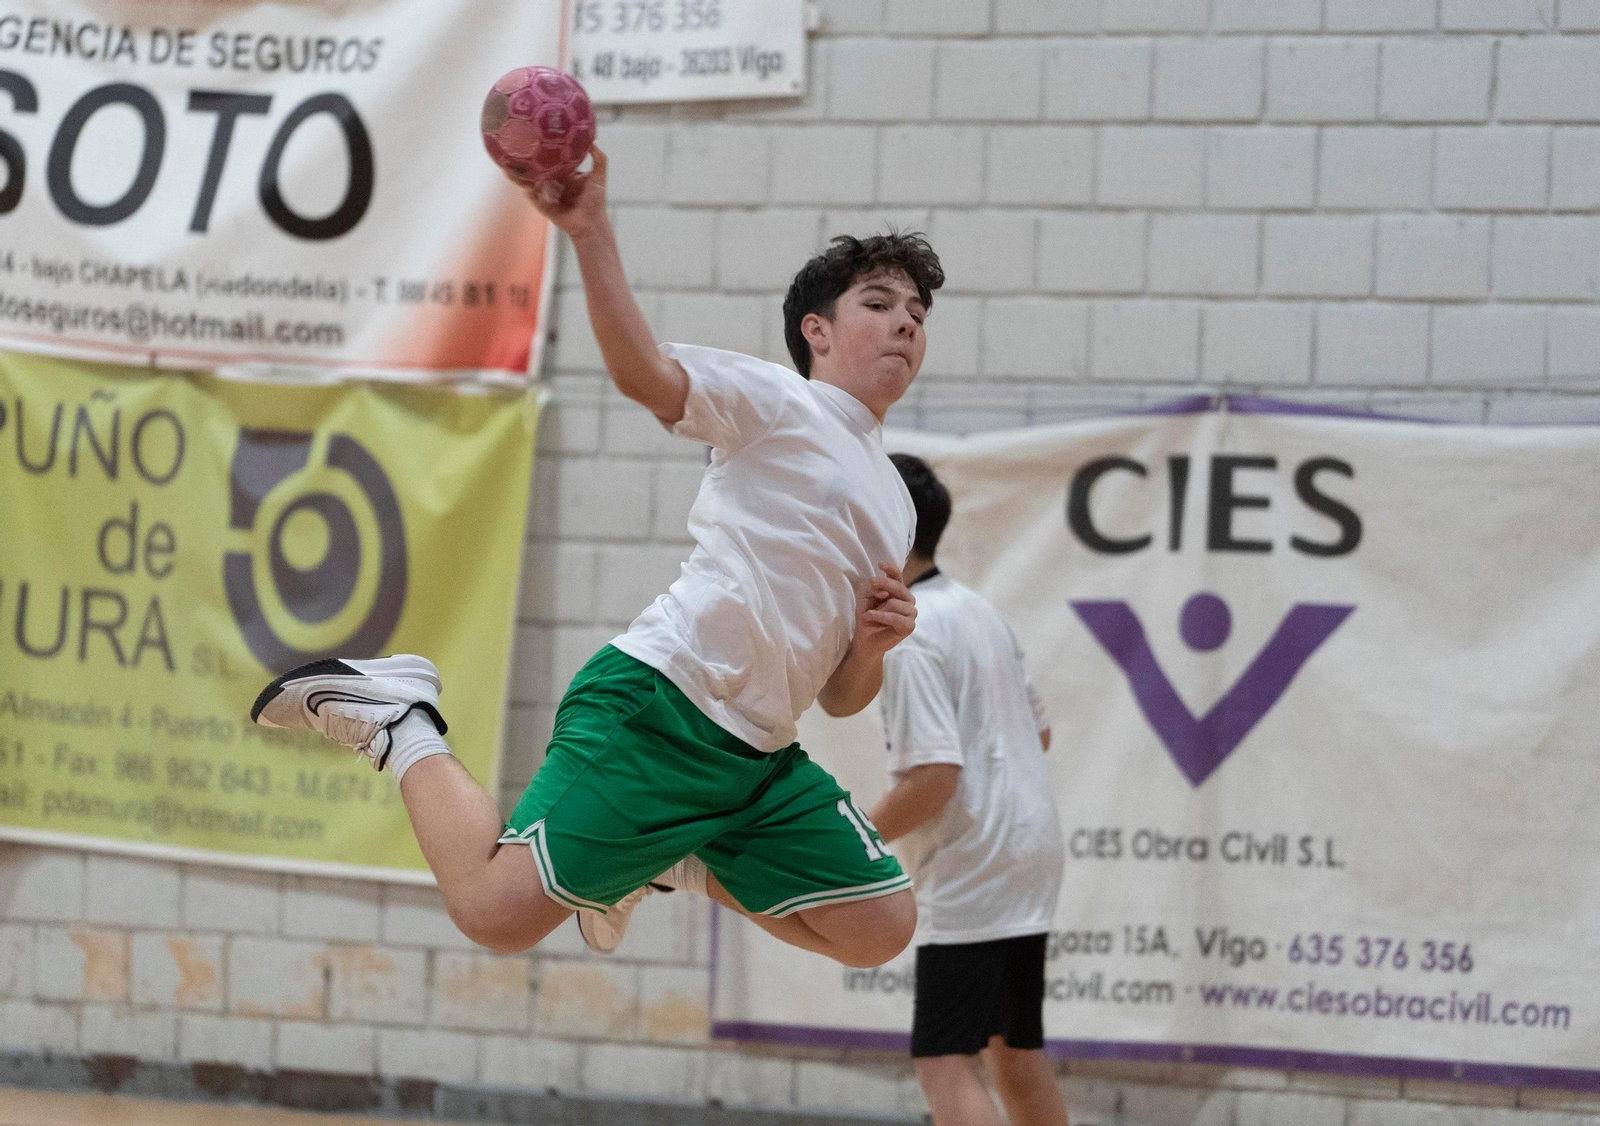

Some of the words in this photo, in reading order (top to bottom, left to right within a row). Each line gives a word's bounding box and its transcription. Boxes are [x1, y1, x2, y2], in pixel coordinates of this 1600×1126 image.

[0, 15, 138, 63] GENCIA
[148, 28, 197, 66] DE
[206, 31, 383, 73] SEGUROS
[78, 257, 189, 293] CHAPELA
[0, 294, 345, 347] oseguros@hotmail.com
[0, 388, 186, 486] UÑO
[1065, 454, 1363, 558] CIES
[96, 499, 176, 580] de
[0, 578, 177, 673] URA
[1069, 827, 1123, 860] CIES
[1132, 827, 1210, 861] Obra
[1220, 831, 1289, 865] Civil
[1297, 834, 1347, 868] S.L.
[1195, 925, 1268, 968] Vigo
[1288, 932, 1344, 965] 635
[1355, 935, 1408, 970] 376
[1419, 940, 1474, 974] 356
[1047, 971, 1175, 1006] civil.com
[1201, 980, 1571, 1030] www.ciesobracivil.com
